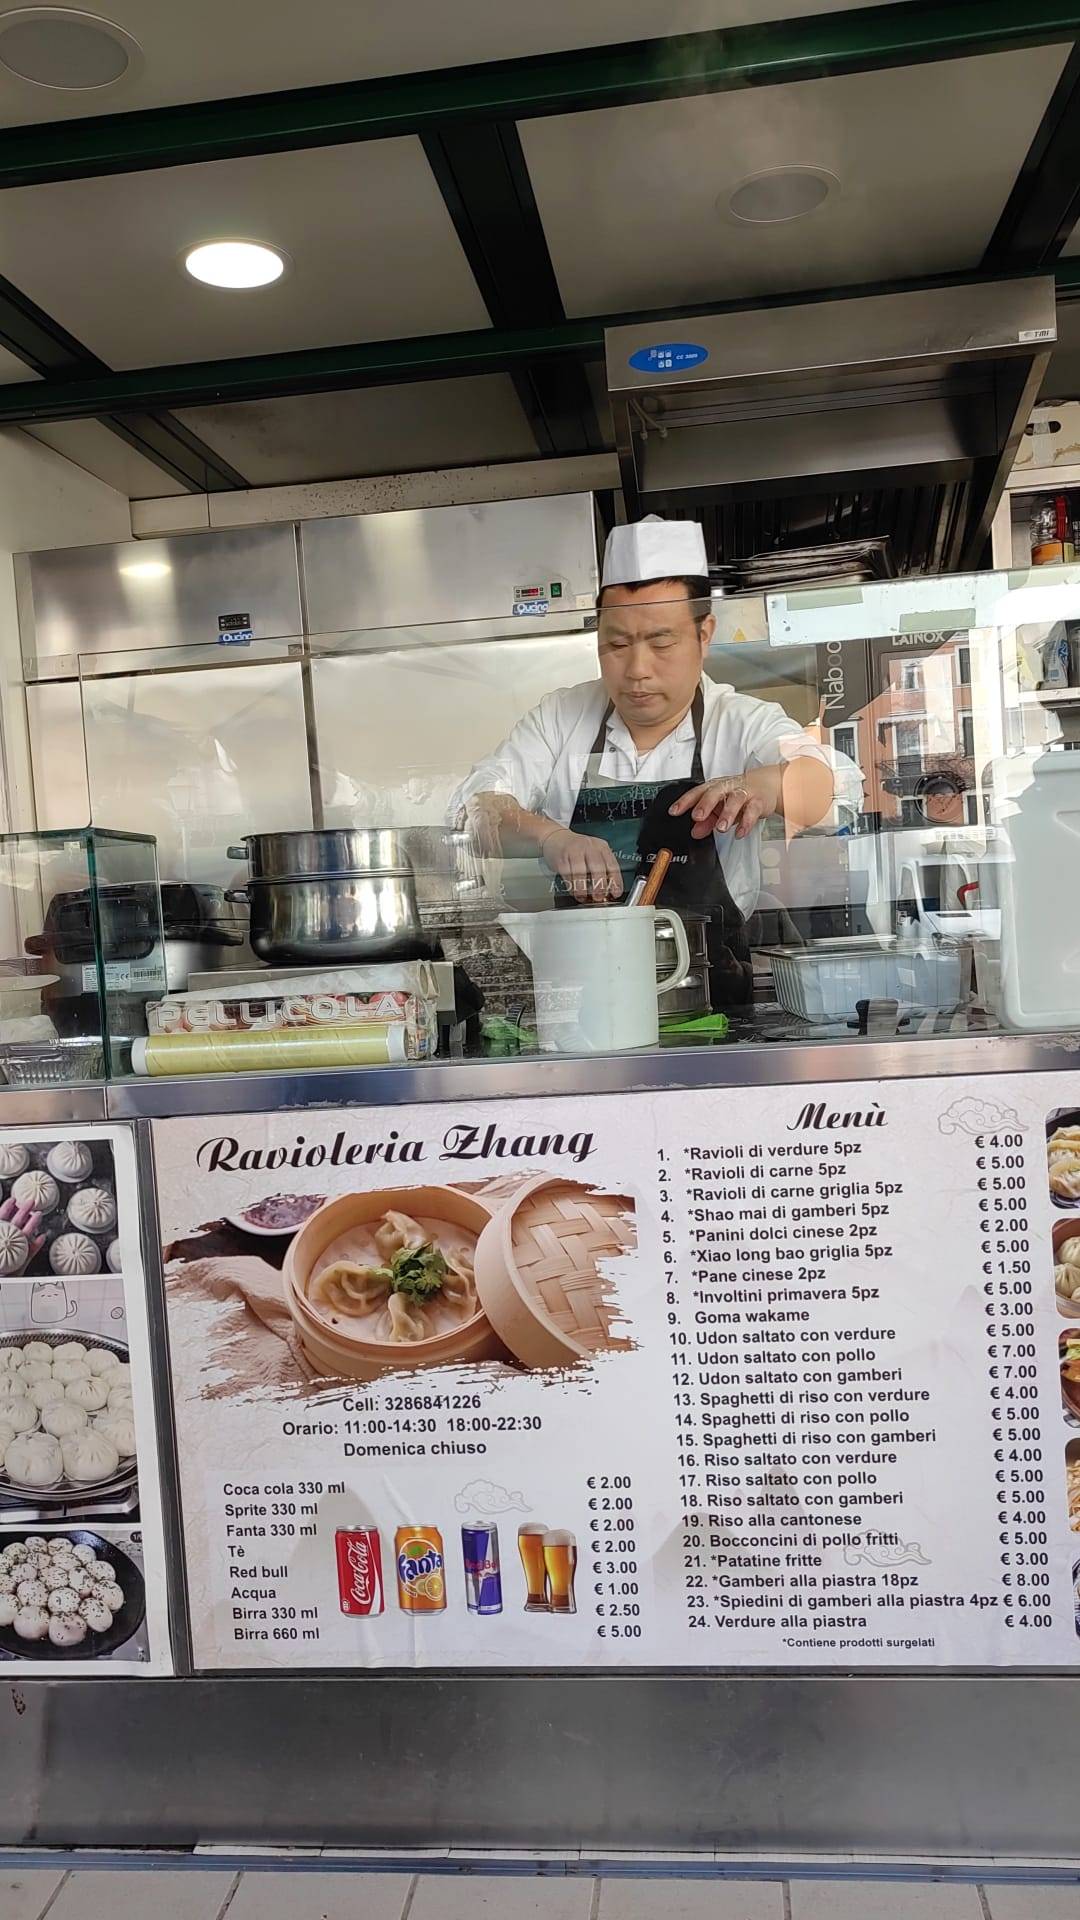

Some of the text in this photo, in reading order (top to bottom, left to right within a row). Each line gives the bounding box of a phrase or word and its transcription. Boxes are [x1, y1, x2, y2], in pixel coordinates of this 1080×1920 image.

[892, 632, 947, 646] LAINOX
[823, 640, 846, 709] Naboo
[645, 853, 688, 864] Zng
[155, 992, 402, 1029] PELLICOLA
[786, 1102, 888, 1131] Menù
[196, 1123, 598, 1172] Ravioleria Zhang
[974, 1134, 1023, 1149] € 4.00
[657, 1149, 670, 1161] 1.
[748, 1144, 763, 1158] di
[767, 1142, 829, 1157] verdure
[834, 1141, 862, 1157] 5pz
[750, 1165, 764, 1178] di
[769, 1166, 813, 1178] carne
[818, 1162, 846, 1178] 5pz
[751, 1185, 765, 1199] di
[770, 1187, 815, 1198] carne
[819, 1182, 870, 1200] griglia
[875, 1181, 903, 1197] 5pz
[739, 1206, 767, 1220] mai
[772, 1205, 786, 1219] di
[791, 1203, 856, 1221] gamberi
[861, 1202, 889, 1218] 5pz
[749, 1226, 788, 1240] dolci
[793, 1225, 844, 1239] cinese
[849, 1224, 878, 1240] 2pz
[736, 1248, 770, 1264] long
[775, 1247, 805, 1260] bao
[809, 1245, 860, 1262] griglia
[865, 1244, 893, 1260] 5pz
[742, 1268, 793, 1282] cinese
[798, 1267, 826, 1283] 2pz
[982, 1260, 1031, 1275] € 1.50
[767, 1288, 846, 1305] primavera
[852, 1286, 880, 1302] 5pz
[695, 1309, 810, 1324] Goma wakame
[696, 1327, 896, 1345] Udon saltato con verdure
[697, 1348, 876, 1365] Udon saltato con pollo
[699, 1368, 902, 1385] Udon saltato con gamberi
[343, 1394, 481, 1412] Cell: 3286841226
[700, 1388, 930, 1408] Spaghetti di riso con verdure
[283, 1416, 542, 1436] Orario: 11:00-14:30 18:00-22:30
[702, 1409, 910, 1429] Spaghetti di riso con pollo
[703, 1429, 936, 1449] Spaghetti di riso con gamberi
[344, 1440, 487, 1456] Domenica chiuso
[704, 1450, 897, 1466] Riso saltato con verdure
[587, 1476, 631, 1489] € 2.00
[706, 1471, 877, 1488] Riso saltato con pollo
[223, 1481, 345, 1496] Coca cola 330 ml
[707, 1491, 903, 1508] Riso saltato con gamberi
[225, 1502, 318, 1519] Sprite 330 ml
[708, 1513, 862, 1527] Riso alla cantonese
[226, 1523, 317, 1537] Fanta 330 ml
[710, 1531, 898, 1549] Bocconcini di pollo fritti
[227, 1545, 245, 1558] Tè
[785, 1554, 822, 1567] fritte
[229, 1565, 288, 1578] Red bull
[790, 1574, 817, 1587] alla
[822, 1574, 876, 1590] piastra
[881, 1573, 919, 1589] 18pz
[231, 1587, 276, 1602] Acqua
[788, 1594, 802, 1607] di
[807, 1594, 872, 1610] gamberi
[877, 1594, 904, 1607] alla
[910, 1594, 965, 1610] piastra
[969, 1593, 999, 1609] 4pz
[232, 1606, 318, 1619] Birra 330 ml
[595, 1603, 640, 1616] € 2.50
[714, 1614, 867, 1630] Verdure alla piastra
[234, 1627, 319, 1640] Birra 660 ml
[839, 1638, 883, 1649] prodotti
[886, 1638, 935, 1649] surgelati
